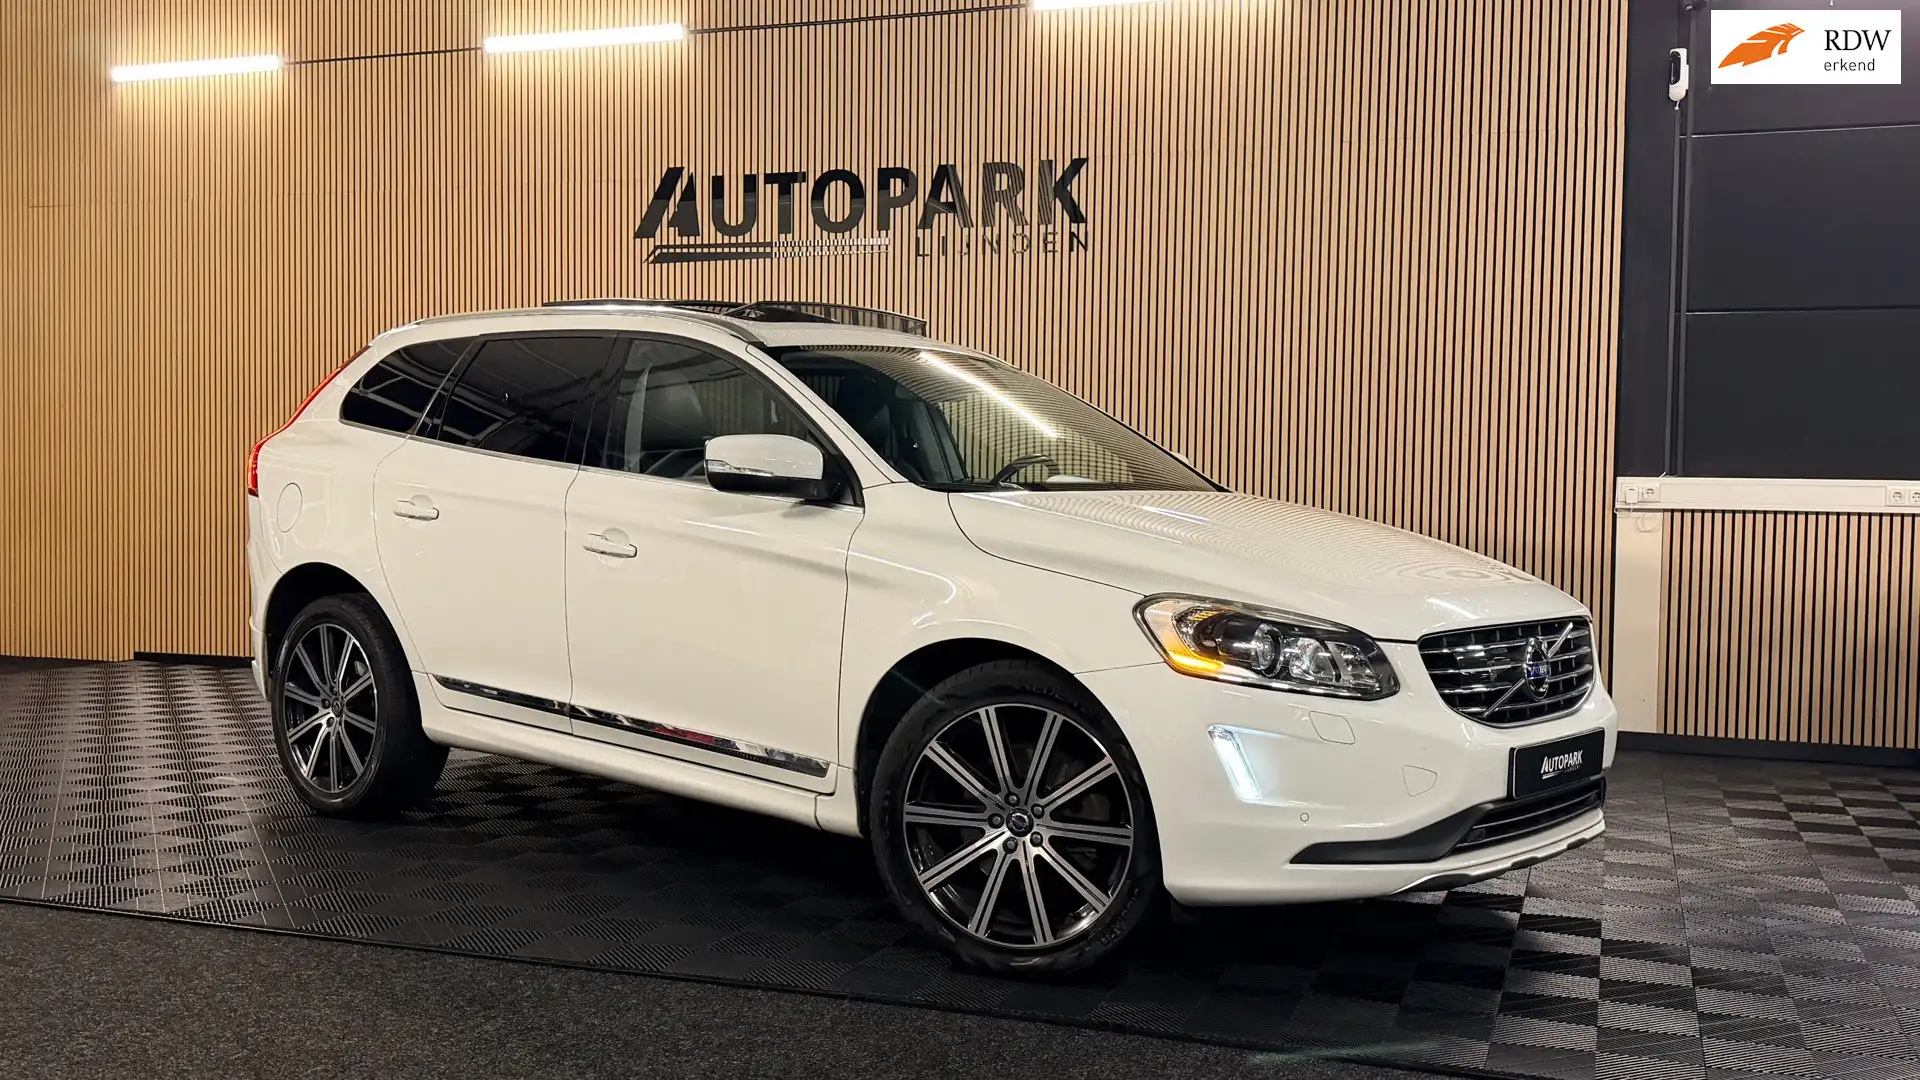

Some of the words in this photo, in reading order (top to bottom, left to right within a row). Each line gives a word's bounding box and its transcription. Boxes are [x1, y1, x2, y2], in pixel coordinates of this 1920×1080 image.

[634, 157, 1089, 239] AUTOPARK
[916, 230, 1089, 257] LIJNDEN
[1540, 749, 1583, 774] AUTOPARK
